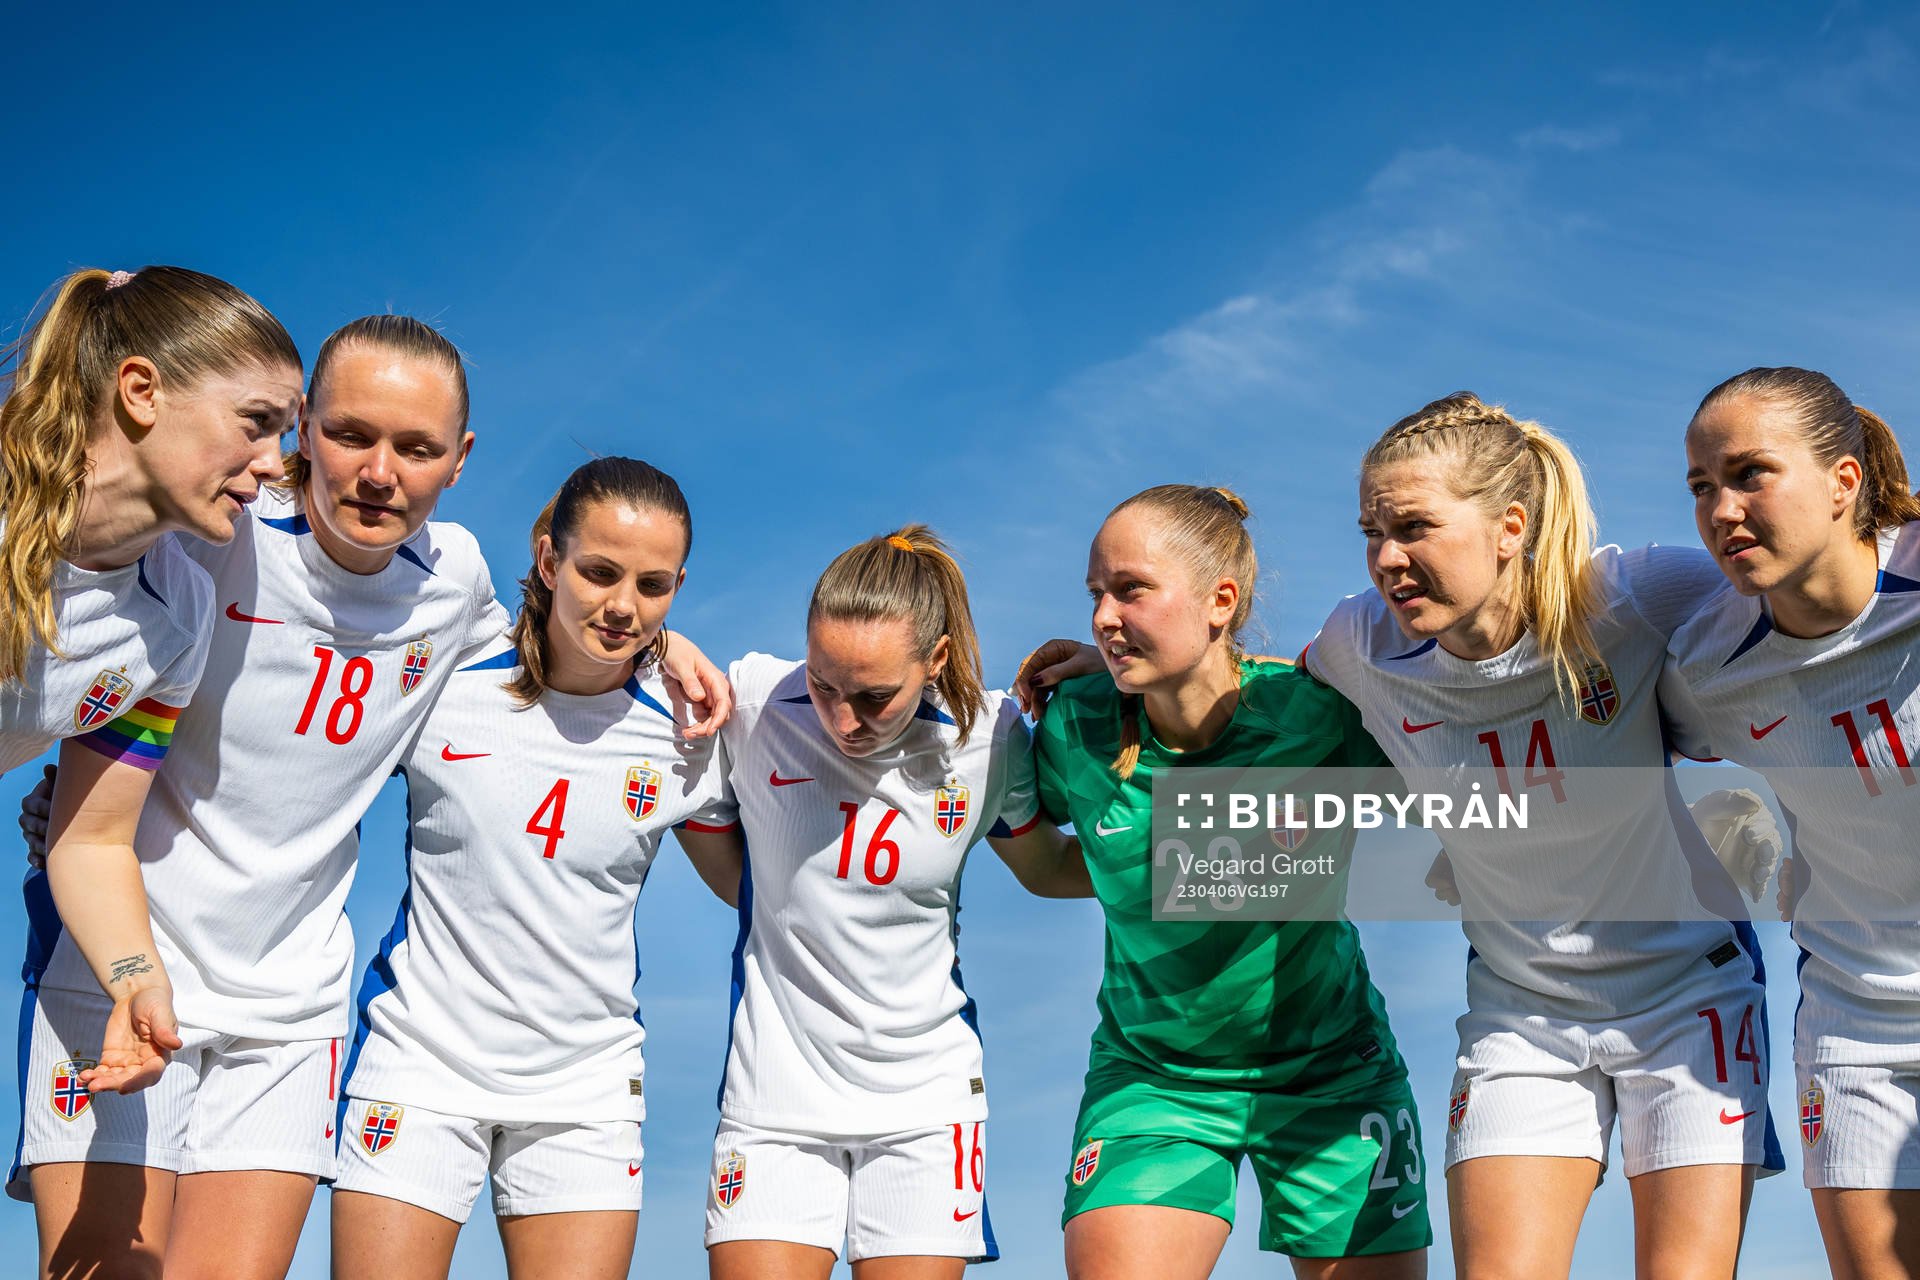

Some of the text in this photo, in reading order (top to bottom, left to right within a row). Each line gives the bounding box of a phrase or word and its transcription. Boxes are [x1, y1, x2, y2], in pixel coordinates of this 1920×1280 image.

[294, 646, 373, 745] 18
[1477, 719, 1567, 805] 14
[1830, 698, 1917, 798] 11
[526, 778, 570, 859] 4
[837, 801, 900, 885] 16
[1155, 836, 1245, 911] 23
[1697, 1004, 1760, 1085] 14
[946, 1122, 984, 1192] 16
[1360, 1108, 1420, 1190] 23
